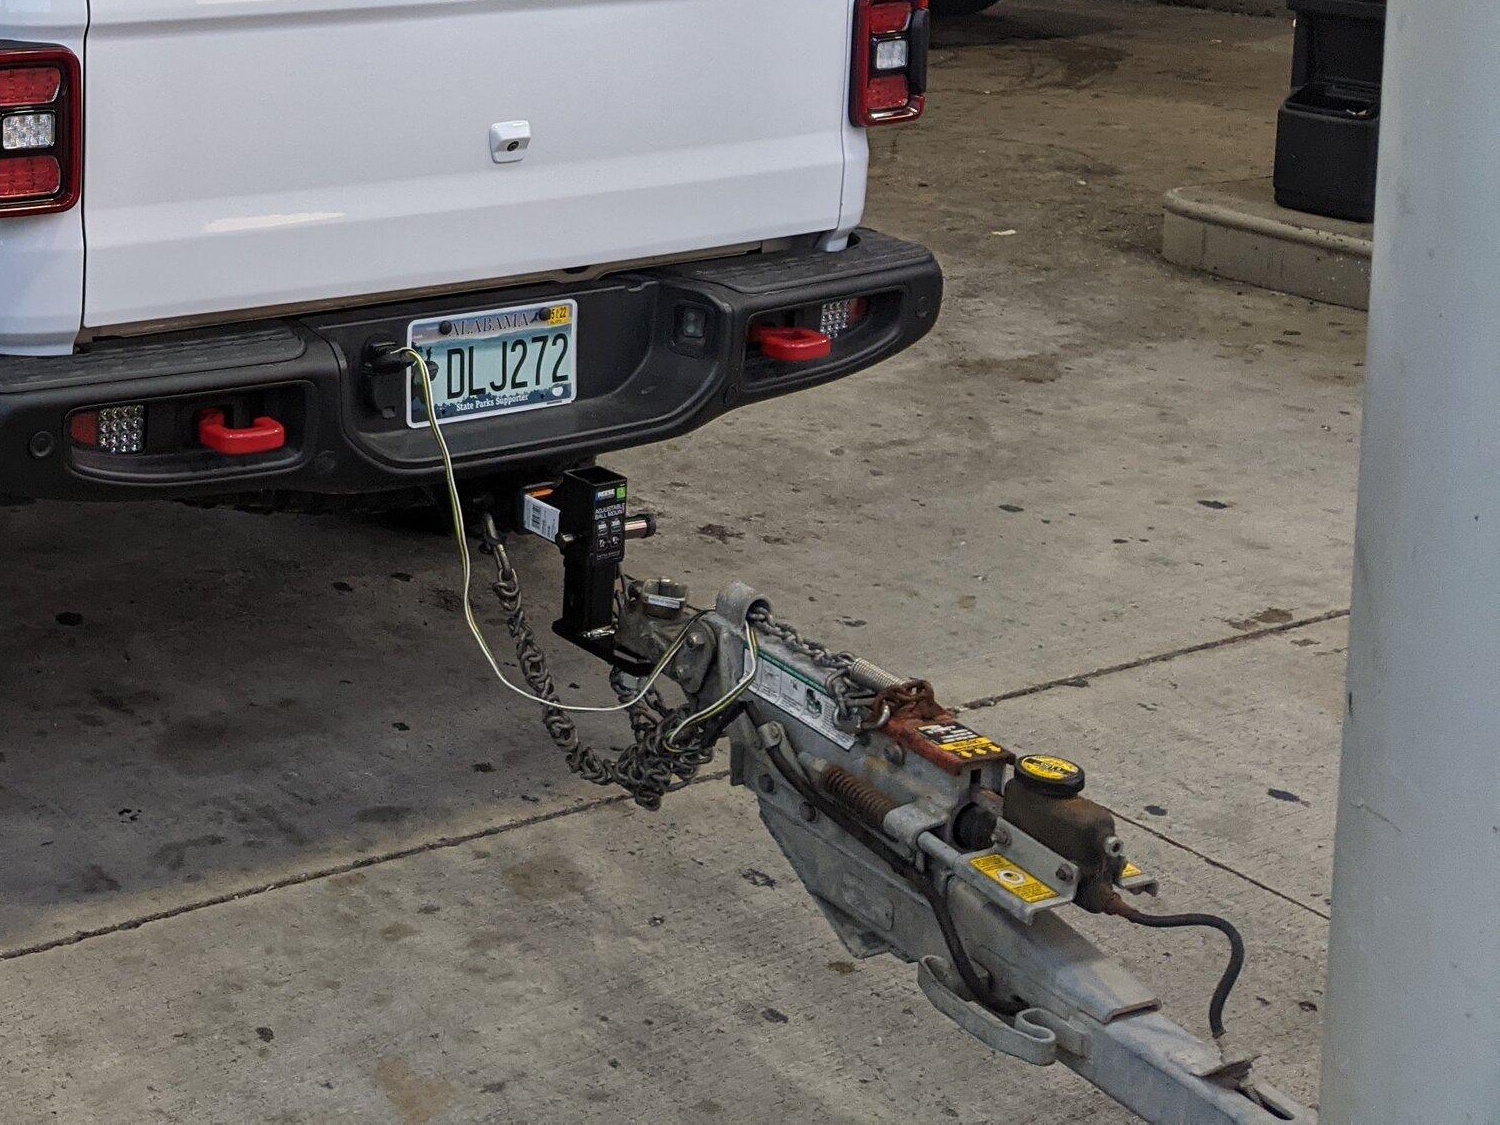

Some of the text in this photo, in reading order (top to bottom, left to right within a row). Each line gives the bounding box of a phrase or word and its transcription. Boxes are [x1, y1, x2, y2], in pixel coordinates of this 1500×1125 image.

[449, 313, 531, 337] ALABAMA
[447, 333, 569, 400] DLJ272
[456, 393, 529, 412] State Parks Supporter
